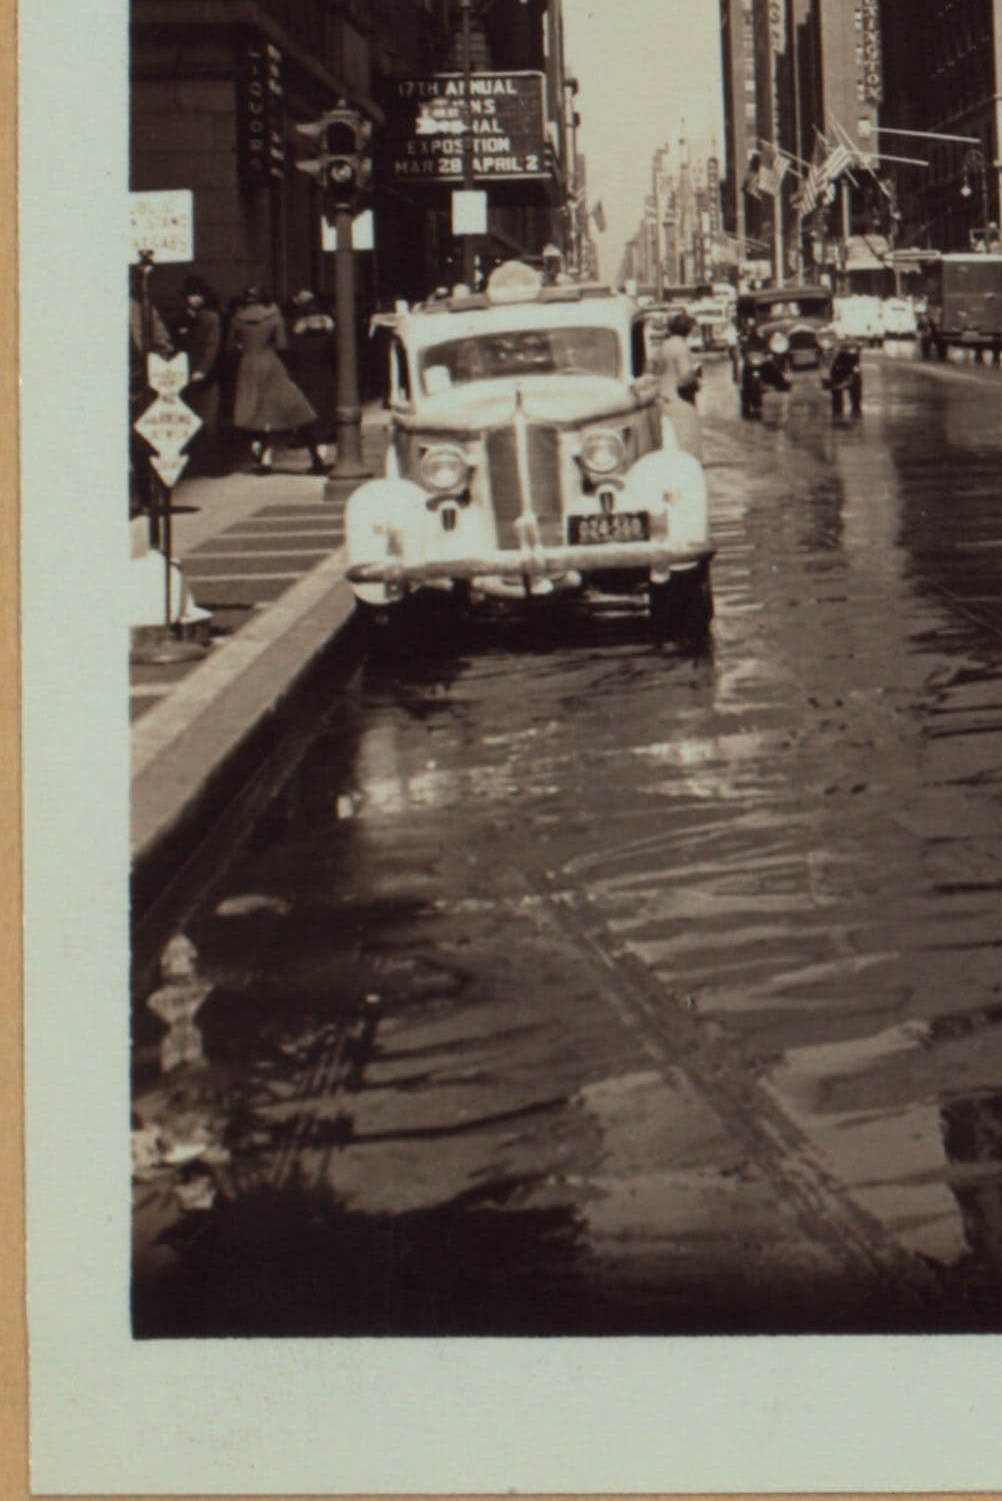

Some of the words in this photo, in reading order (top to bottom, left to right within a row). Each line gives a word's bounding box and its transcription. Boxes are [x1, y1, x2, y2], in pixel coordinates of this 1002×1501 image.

[407, 137, 511, 155] EXPOSTION
[438, 158, 462, 173] 28
[472, 156, 523, 172] APRIL
[525, 154, 538, 171] 2
